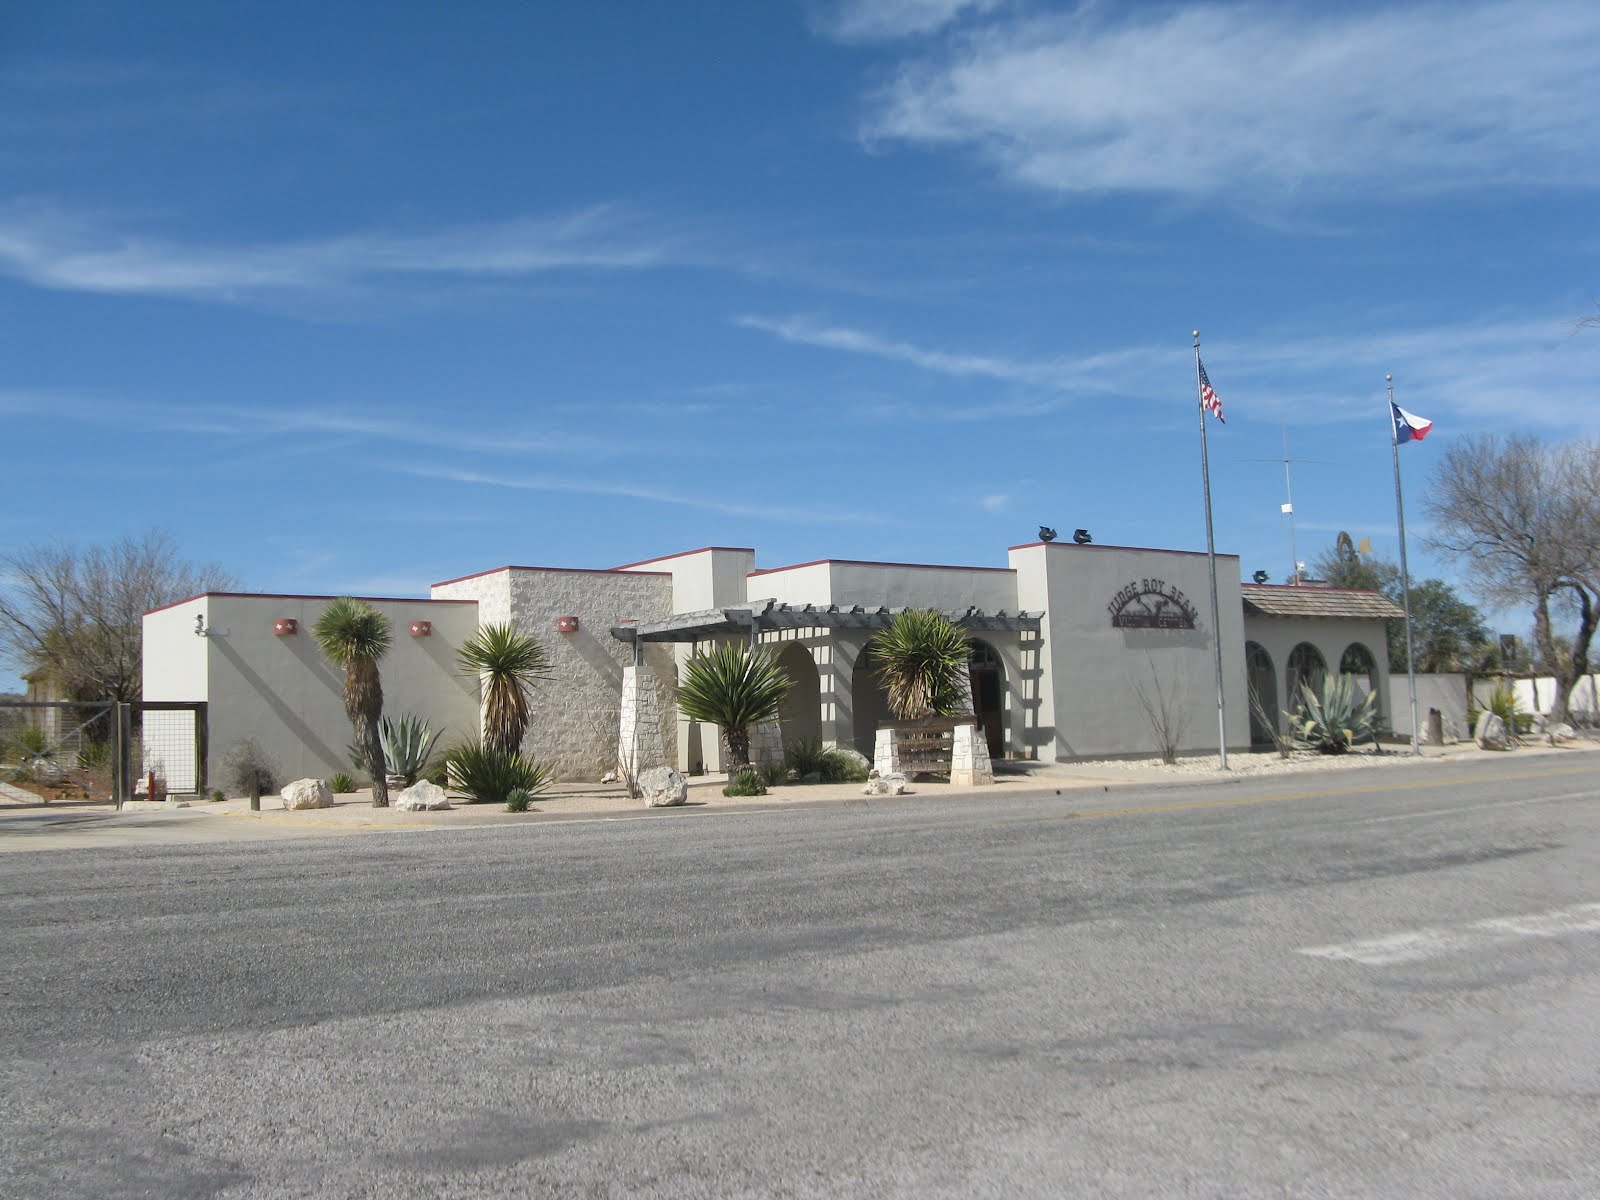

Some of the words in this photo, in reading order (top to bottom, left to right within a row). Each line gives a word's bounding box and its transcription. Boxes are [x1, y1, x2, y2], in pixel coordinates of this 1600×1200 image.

[1107, 581, 1137, 615] JUDGE
[1143, 578, 1165, 592] ROY
[1118, 616, 1151, 627] VISIT
